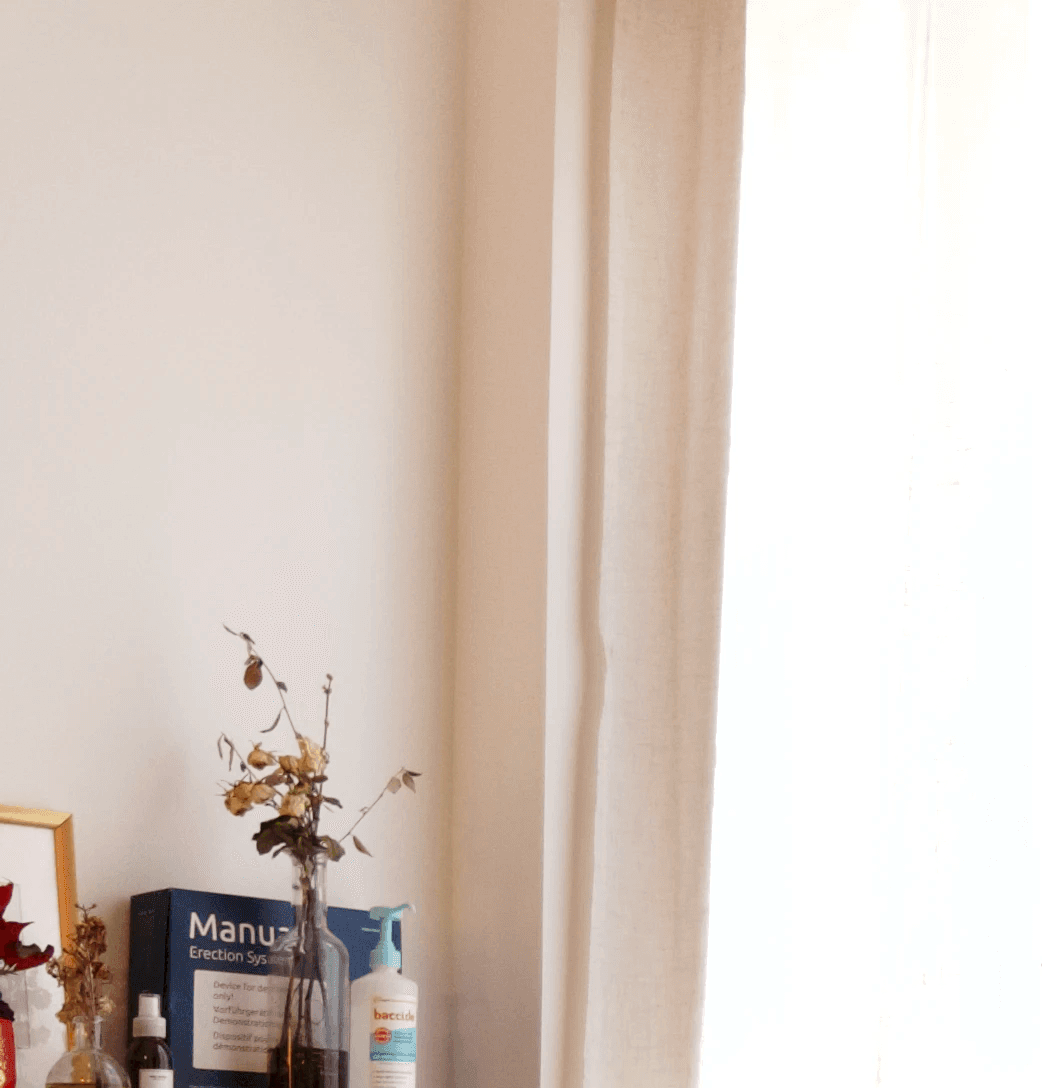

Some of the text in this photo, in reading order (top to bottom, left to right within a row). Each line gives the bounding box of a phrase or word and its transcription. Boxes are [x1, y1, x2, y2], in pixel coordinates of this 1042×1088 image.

[189, 945, 244, 962] Erection
[213, 980, 241, 991] Device
[244, 982, 256, 992] for
